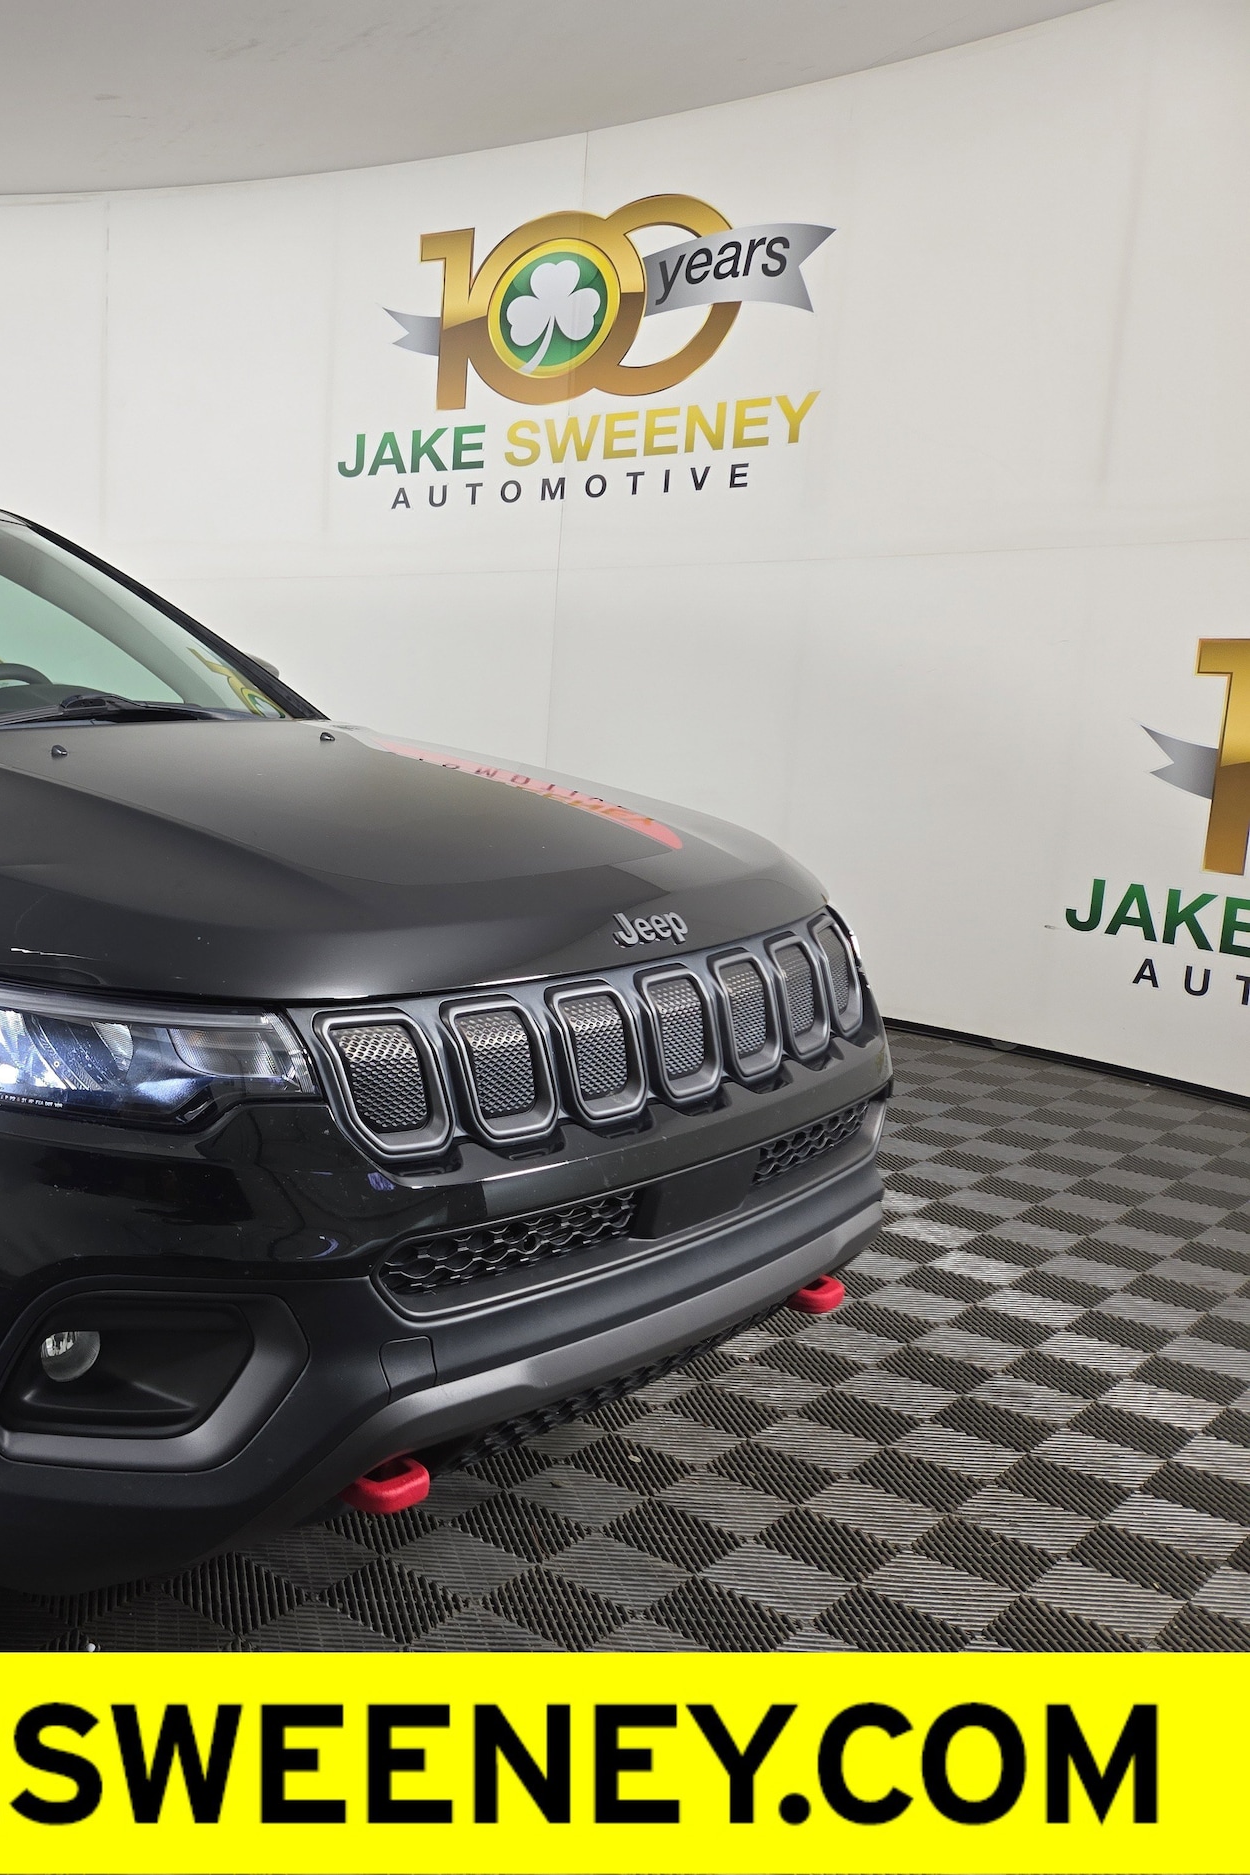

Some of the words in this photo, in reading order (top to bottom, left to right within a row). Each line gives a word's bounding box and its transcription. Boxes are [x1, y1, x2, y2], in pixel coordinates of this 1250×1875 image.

[656, 236, 791, 306] years
[337, 425, 486, 479] JAKE
[504, 391, 822, 468] SWEENEY
[390, 463, 750, 510] AUTOMOTIVE
[613, 912, 688, 947] Jeep
